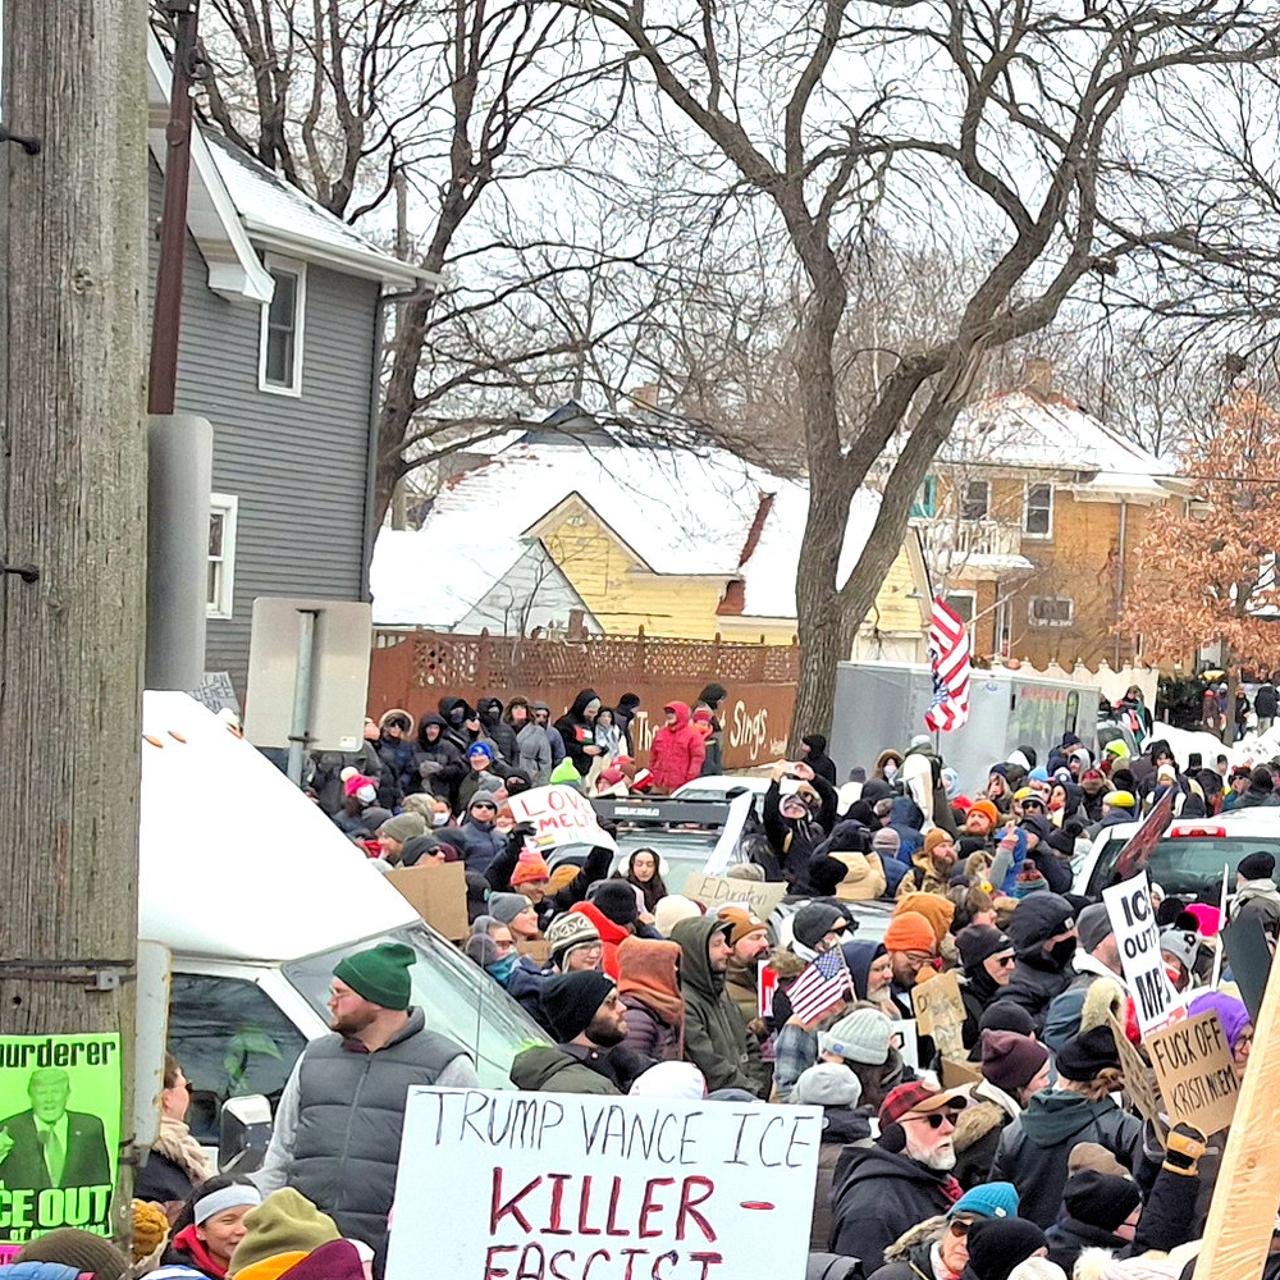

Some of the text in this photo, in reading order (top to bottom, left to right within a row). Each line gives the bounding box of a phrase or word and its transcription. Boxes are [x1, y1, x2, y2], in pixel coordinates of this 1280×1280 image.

[0, 1038, 117, 1068] urderer
[1153, 1016, 1222, 1077] FUCK OFF
[1171, 1075, 1207, 1120] KRISTI
[414, 1090, 815, 1167] TRUMP VANCE ICE
[0, 1184, 112, 1228] CE OUT
[490, 1167, 718, 1241] KILLER
